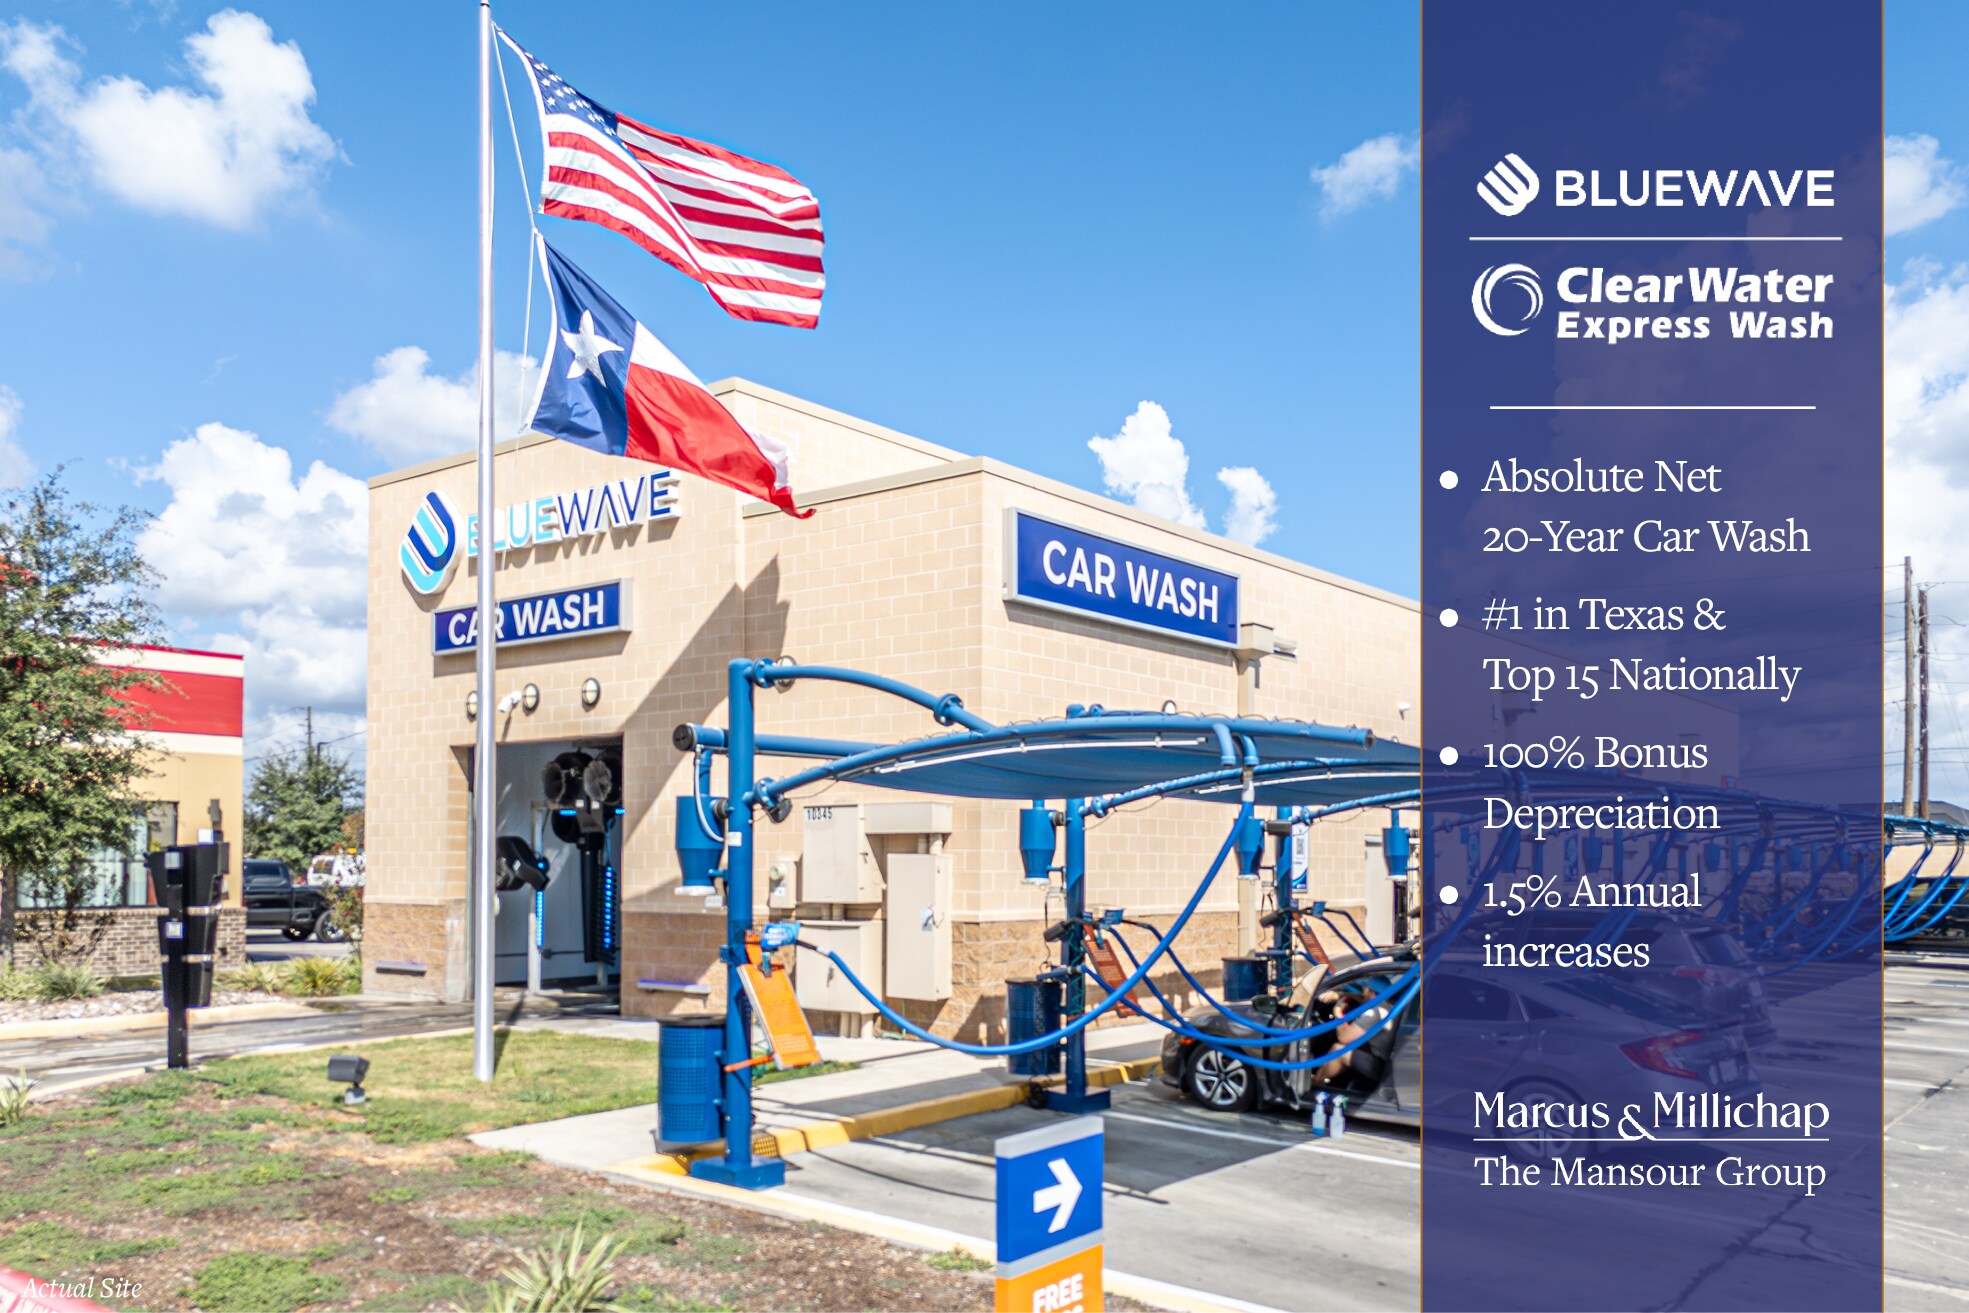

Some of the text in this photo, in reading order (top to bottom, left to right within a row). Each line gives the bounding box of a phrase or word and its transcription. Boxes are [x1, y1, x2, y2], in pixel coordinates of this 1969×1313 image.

[1042, 540, 1219, 623] CAR WASH
[512, 590, 605, 637] WASH
[1032, 1272, 1084, 1313] FREE
